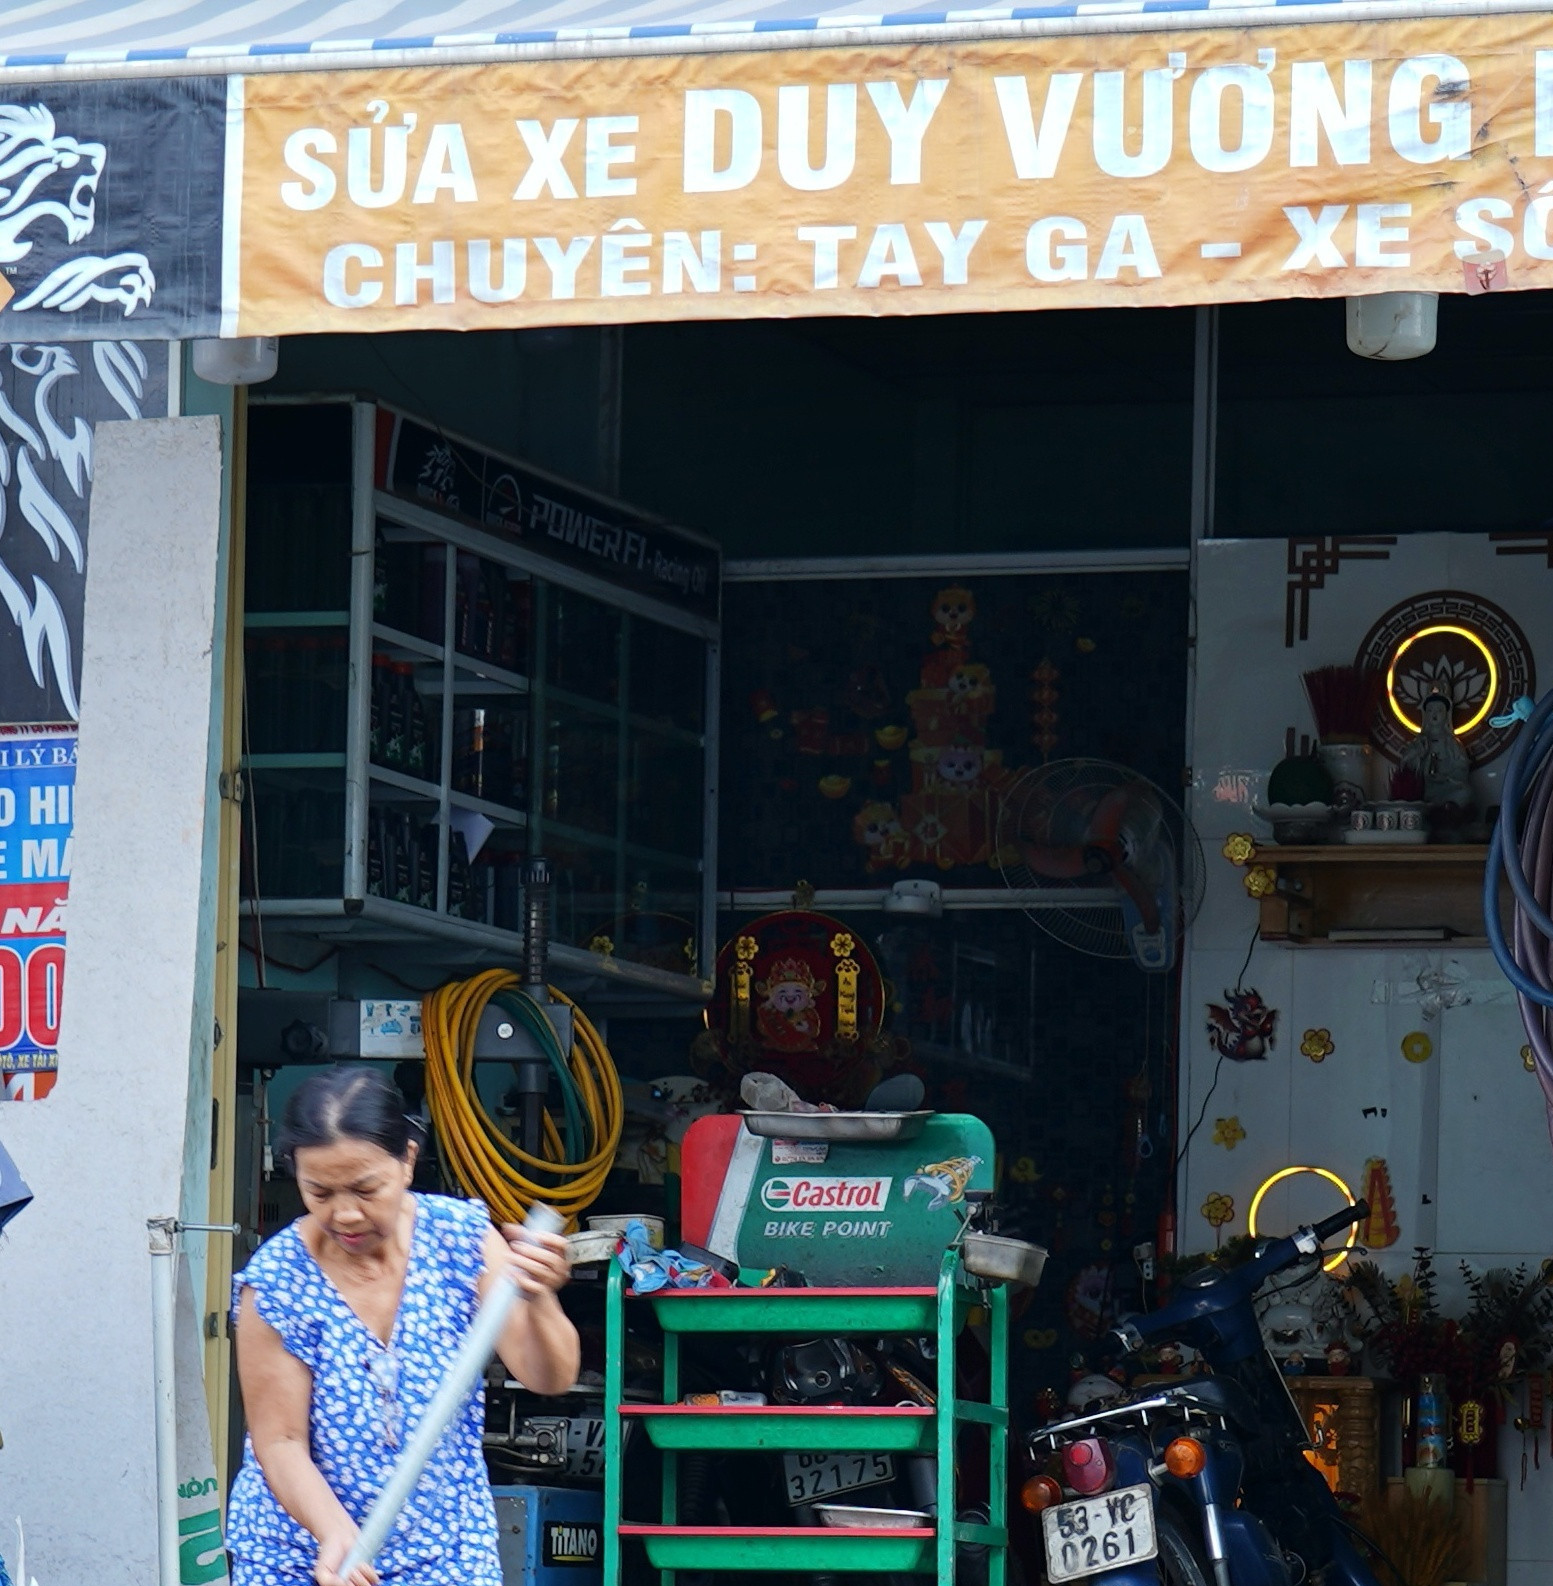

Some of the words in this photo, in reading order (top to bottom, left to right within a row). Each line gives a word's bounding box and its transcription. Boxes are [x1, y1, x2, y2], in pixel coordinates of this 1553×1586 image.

[281, 99, 475, 210] SỬA
[513, 114, 639, 202] XE
[682, 78, 950, 194] DUY
[994, 47, 1472, 181] VƯƠNG
[323, 220, 756, 308] CHUYÊN:
[798, 218, 987, 290] TAY
[1025, 214, 1158, 282] GA
[1280, 201, 1412, 272] XE
[15, 743, 46, 766] LÝ
[793, 1181, 882, 1207] Castrol
[764, 1221, 816, 1238] BIKE
[822, 1220, 893, 1238] POINT
[791, 1454, 887, 1499] 321.75
[1061, 1527, 1135, 1573] 0261
